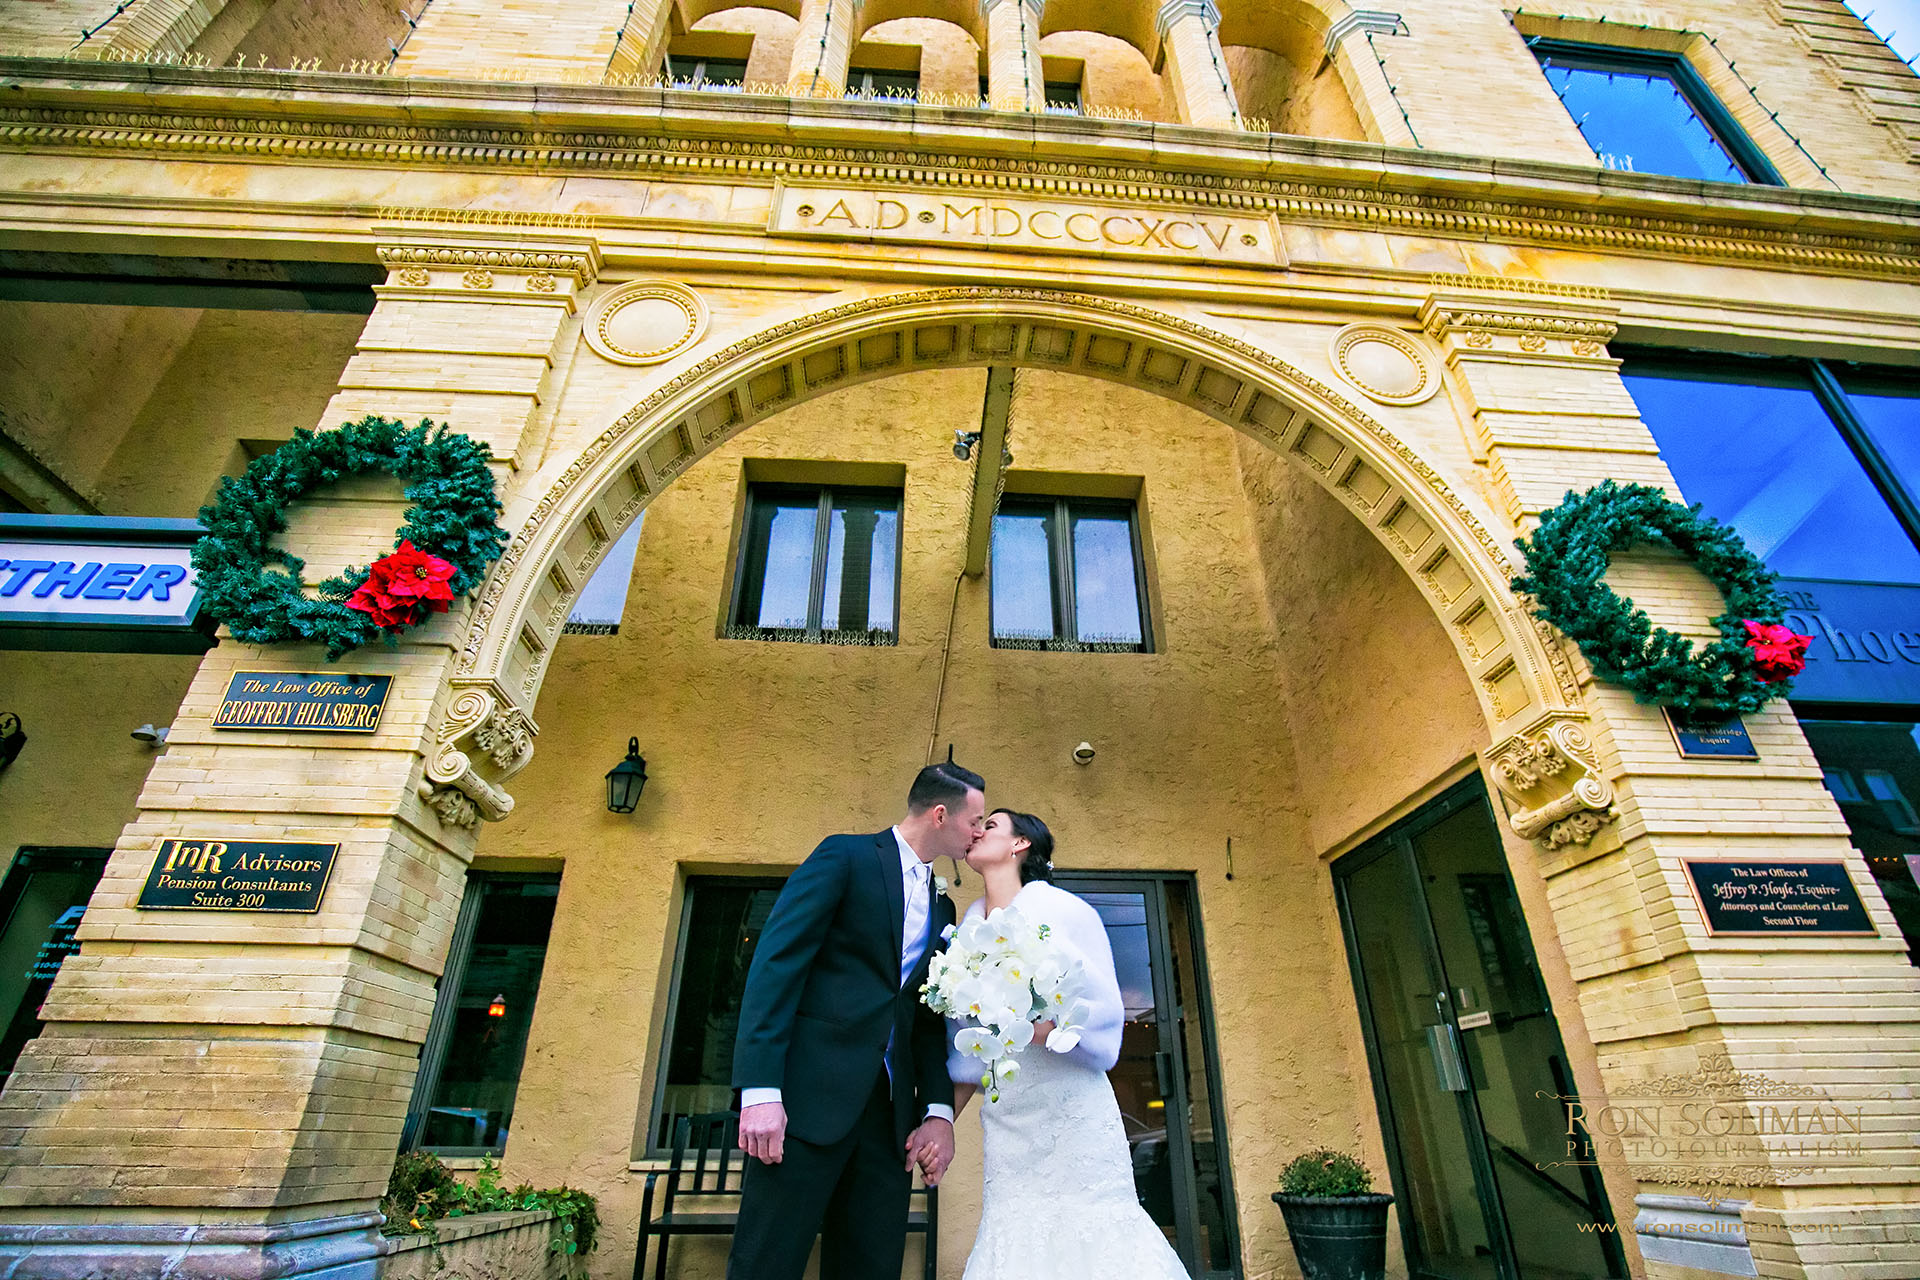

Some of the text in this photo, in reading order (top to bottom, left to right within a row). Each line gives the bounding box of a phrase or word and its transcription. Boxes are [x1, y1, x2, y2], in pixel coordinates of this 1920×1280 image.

[941, 203, 1233, 251] MDCCCXCV
[242, 680, 375, 698] The Law Office of
[217, 700, 380, 728] GEOFFREY HILLSBERG
[161, 841, 322, 875] InR Advisors
[1731, 868, 1809, 877] The Law Offices of
[157, 875, 312, 892] Pension Consultants
[1713, 881, 1748, 899] Jeffrey
[191, 892, 265, 908] Suite 300
[1720, 902, 1849, 913] Attorneys and Counselors at Law
[1763, 916, 1818, 926] Second Floor
